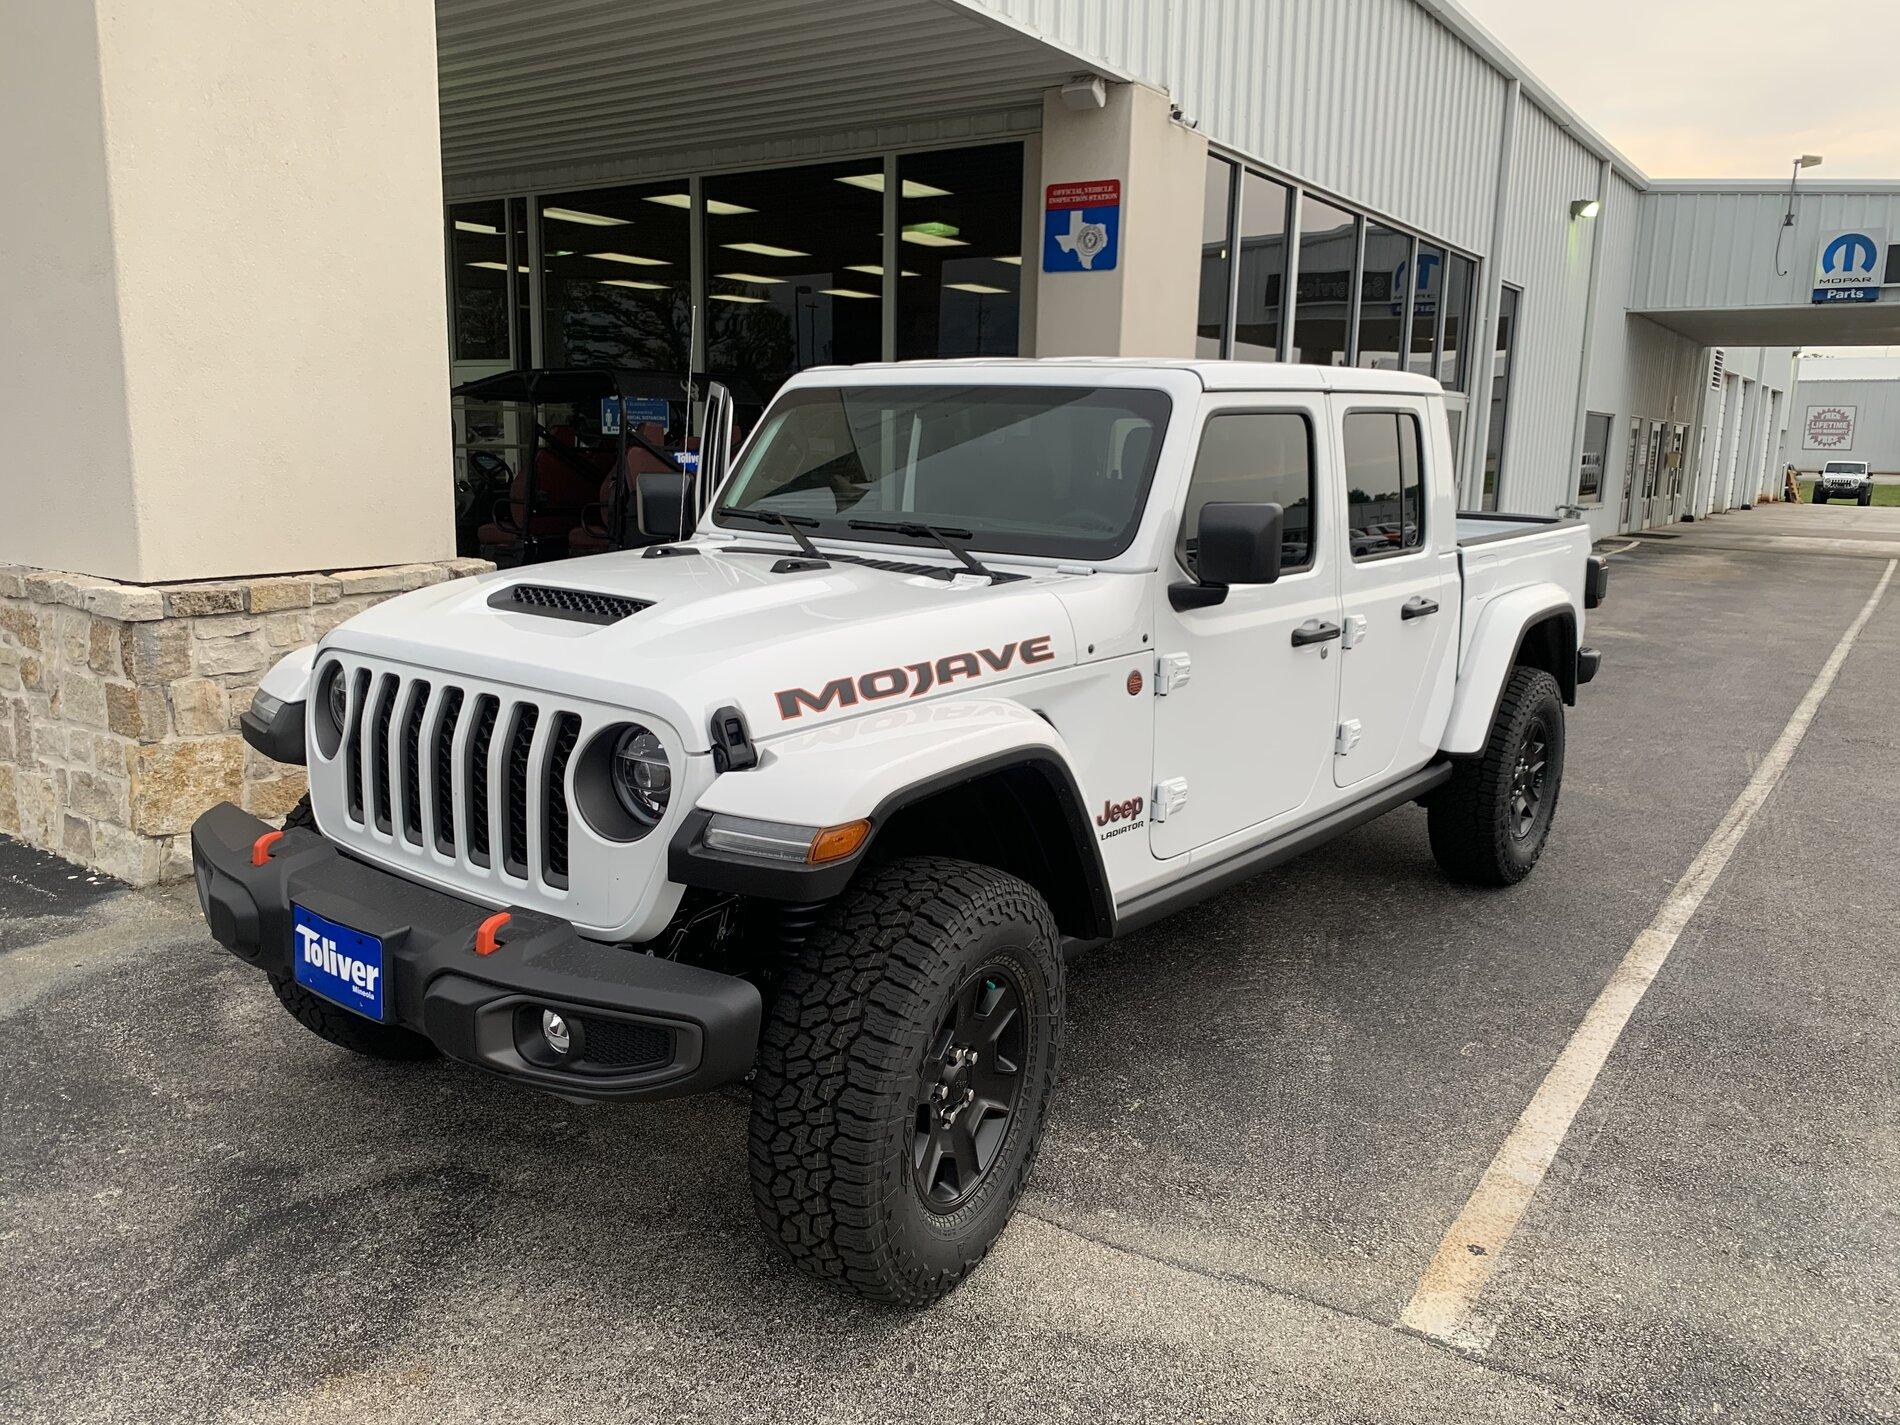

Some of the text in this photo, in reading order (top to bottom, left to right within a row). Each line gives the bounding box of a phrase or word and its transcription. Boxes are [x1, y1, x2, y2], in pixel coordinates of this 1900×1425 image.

[1053, 185, 1114, 196] OFFICIAL VEHICLE
[1048, 192, 1118, 204] INSPECTION STATION
[1820, 277, 1872, 285] MOPAR
[1827, 289, 1864, 299] Parts
[1811, 421, 1849, 429] LIFETIME
[774, 634, 1055, 721] MOJAVE
[1096, 796, 1143, 827] Jeep
[295, 923, 379, 992] Toliver
[352, 985, 375, 1000] Mineola
